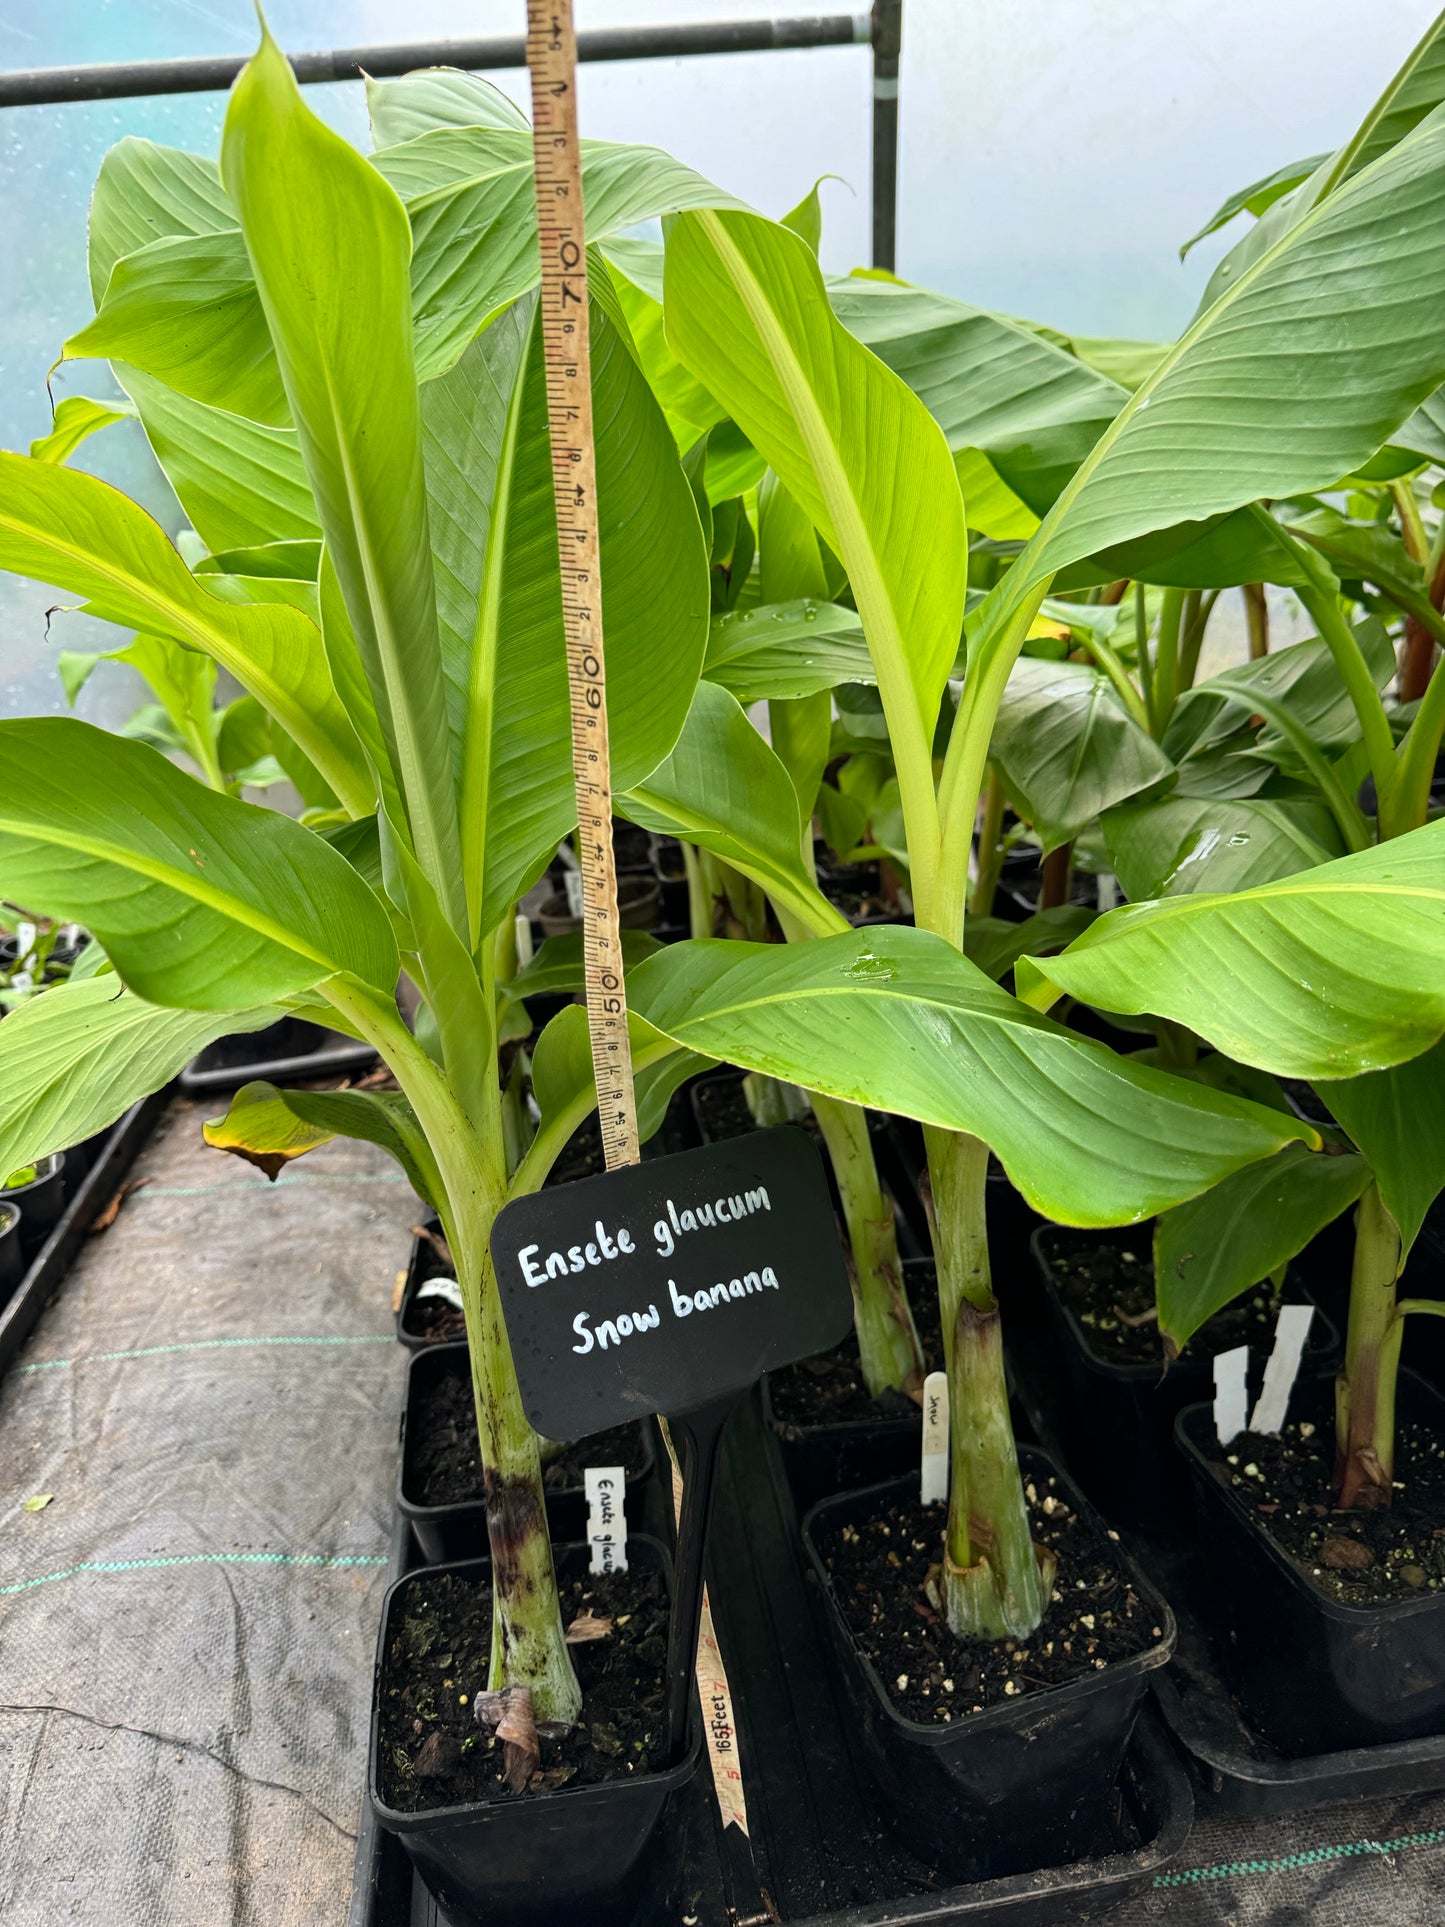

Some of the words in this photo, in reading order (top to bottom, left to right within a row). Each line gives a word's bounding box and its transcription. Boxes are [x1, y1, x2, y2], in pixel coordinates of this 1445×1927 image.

[553, 138, 566, 148] 3
[556, 186, 569, 196] 2
[562, 324, 575, 334] 9
[565, 368, 577, 377] 8
[566, 411, 580, 420] 7
[570, 454, 582, 462] 6
[574, 498, 585, 507] 5
[576, 535, 587, 543] 4
[578, 574, 589, 583] 3
[580, 612, 591, 621] 2
[583, 655, 601, 709] 60
[586, 720, 597, 728] 9
[588, 754, 598, 762] 8
[589, 787, 599, 795] 7
[592, 819, 602, 827] 6
[597, 911, 607, 919] 3
[602, 974, 621, 1014] 50
[605, 1021, 616, 1030] 9
[517, 1220, 636, 1288] Ensete
[653, 1185, 772, 1258] glaucum
[572, 1304, 661, 1355] Snow
[667, 1266, 780, 1318] banana
[598, 1480, 615, 1524] Ensete
[592, 1534, 616, 1573] glacu
[727, 1769, 740, 1780] 5
